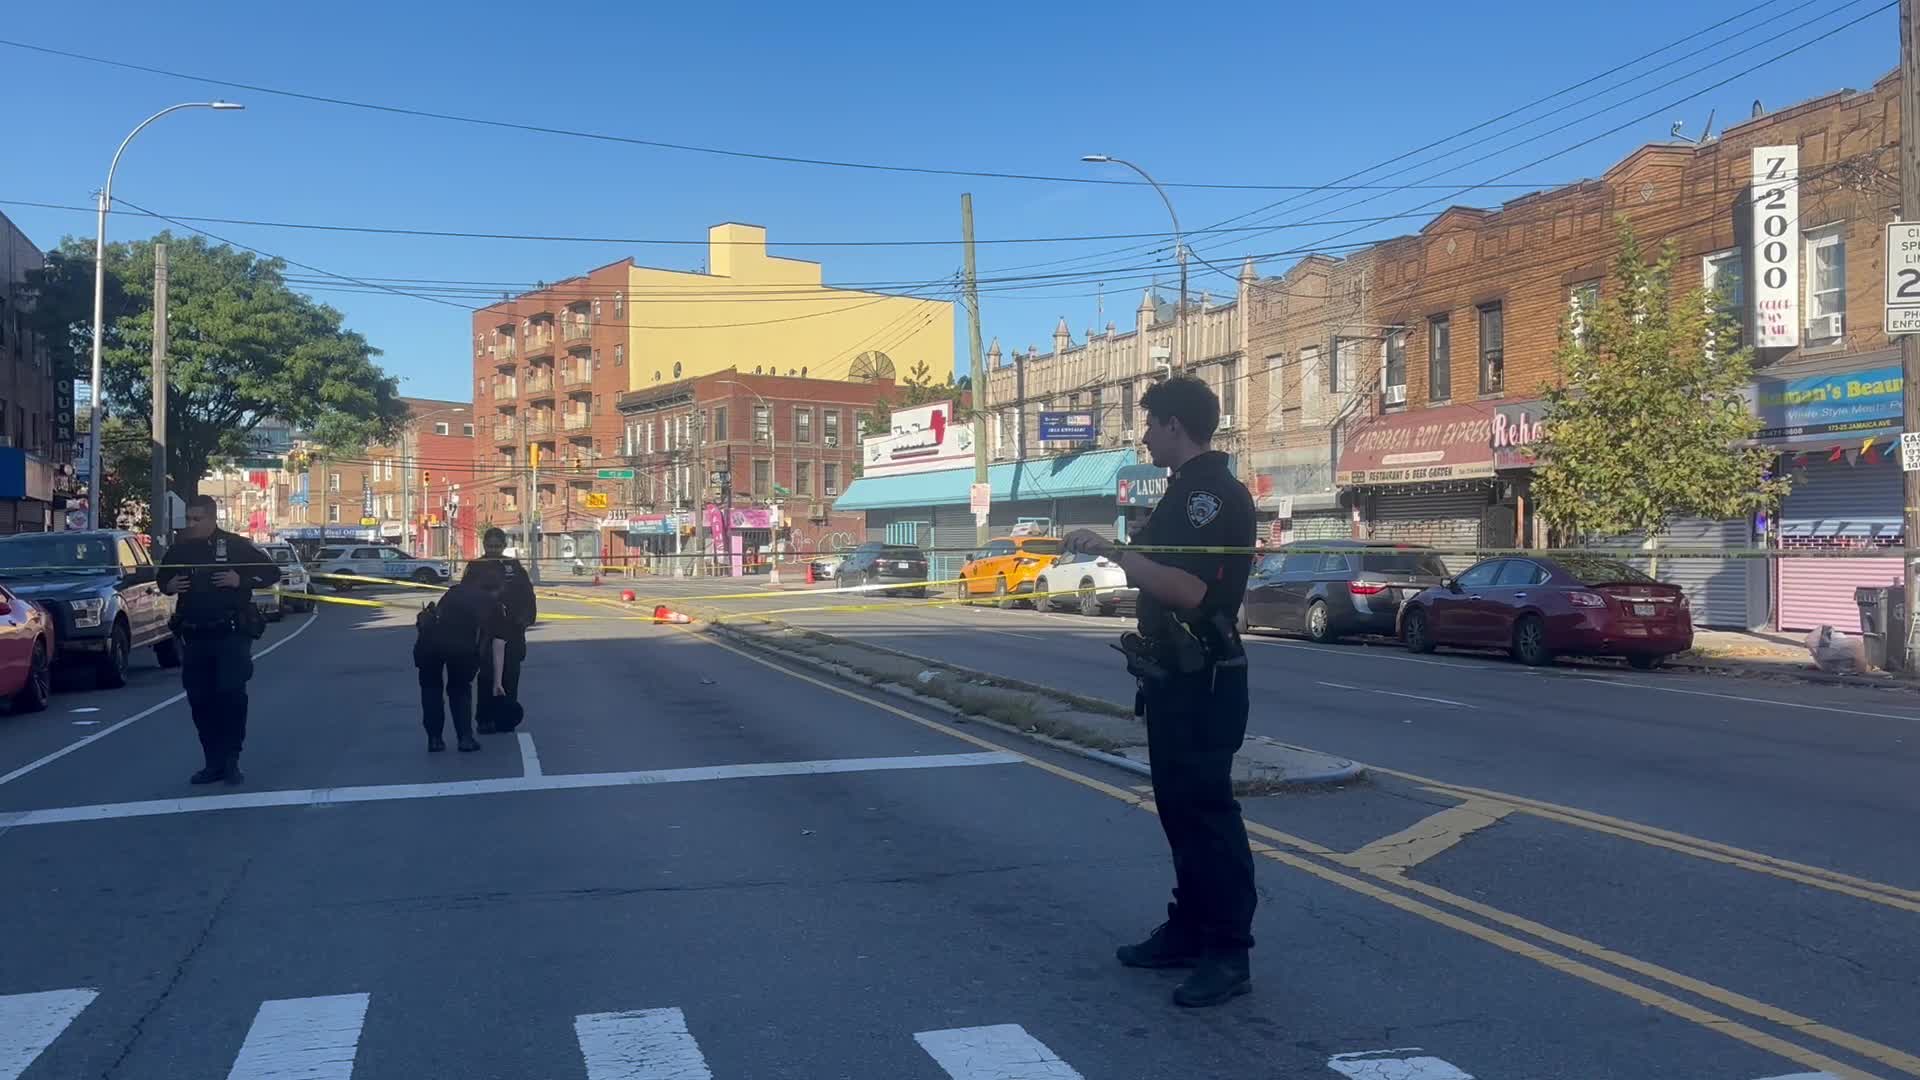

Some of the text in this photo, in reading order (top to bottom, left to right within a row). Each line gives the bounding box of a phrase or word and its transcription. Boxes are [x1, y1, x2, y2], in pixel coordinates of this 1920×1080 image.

[1763, 157, 1787, 289] Z2000
[1903, 310, 1920, 319] PH
[1878, 419, 1891, 427] AVE
[1441, 418, 1491, 446] EXPRESS
[1369, 470, 1403, 481] RESTAURANT
[1412, 468, 1427, 479] BEER
[1428, 466, 1452, 478] GARDEN
[313, 528, 342, 537] Mdical
